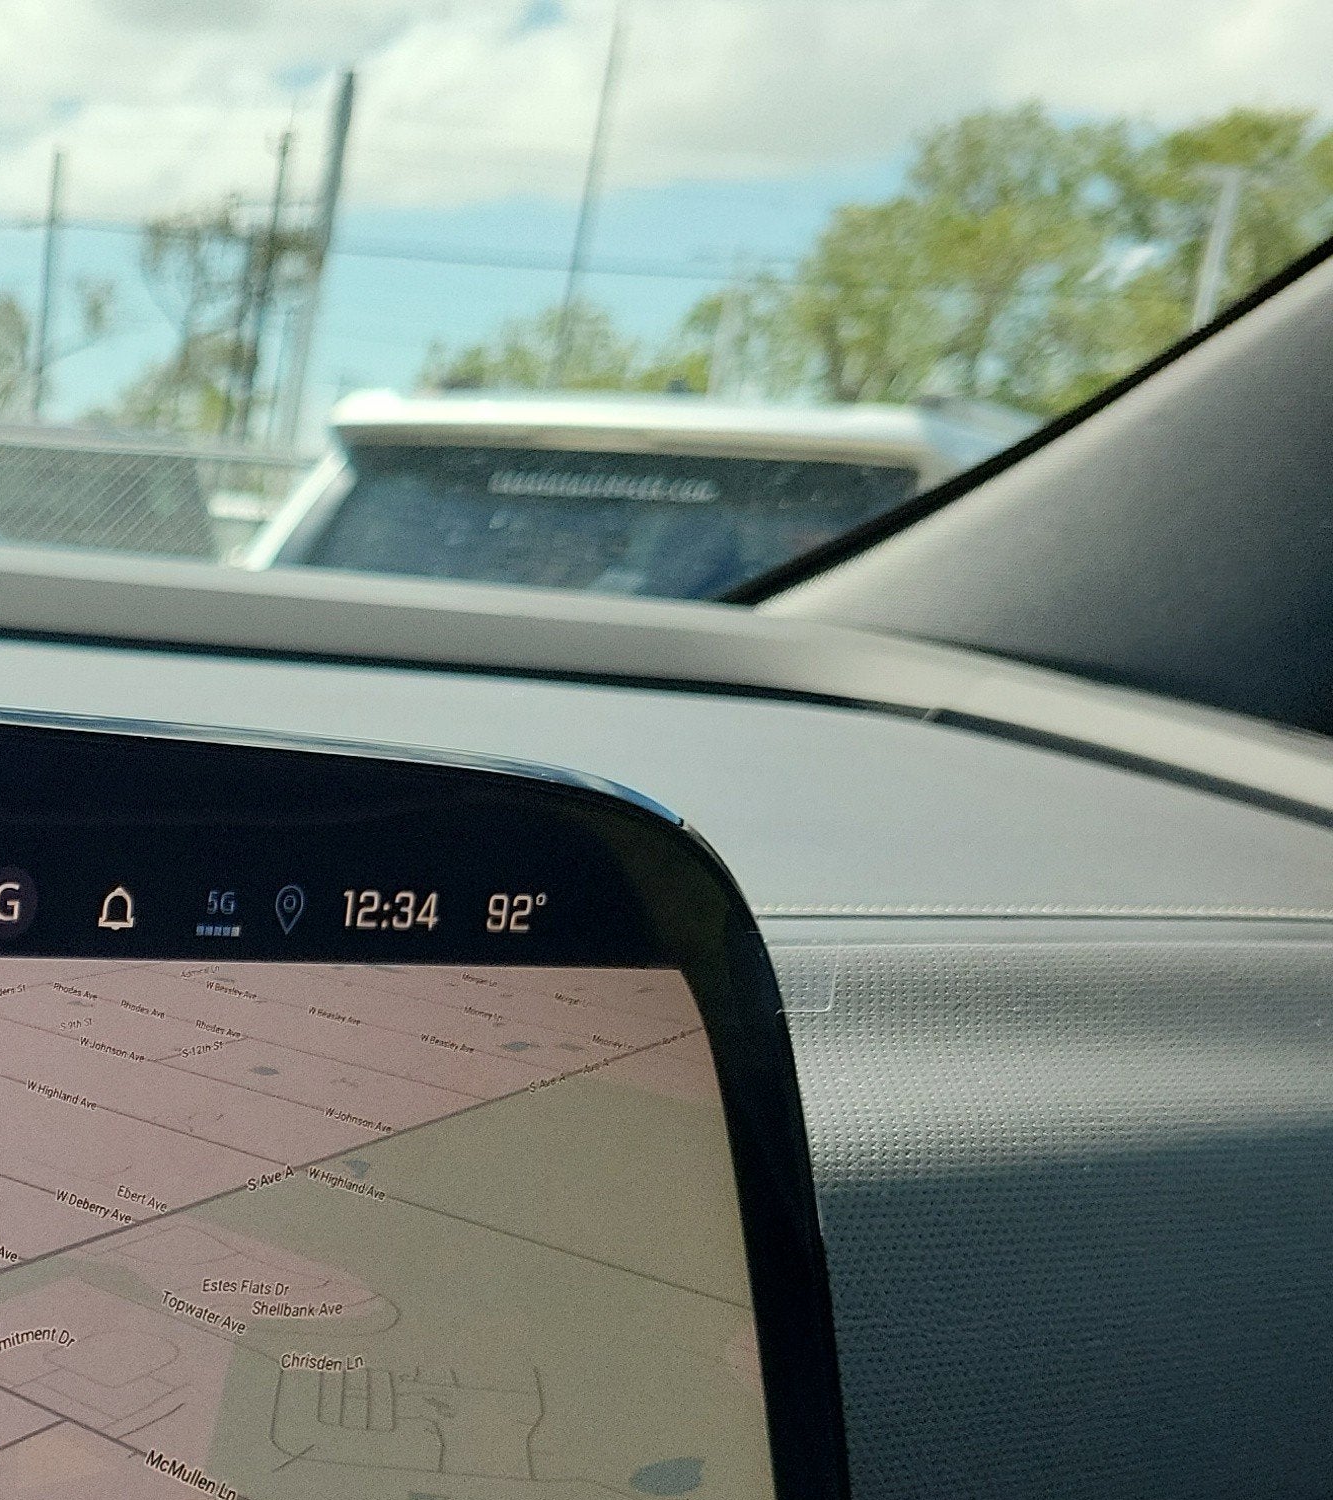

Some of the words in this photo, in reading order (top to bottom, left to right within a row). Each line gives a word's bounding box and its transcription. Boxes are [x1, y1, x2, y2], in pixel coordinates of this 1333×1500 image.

[207, 891, 235, 915] 5G
[342, 890, 439, 931] 12:34
[486, 891, 546, 933] 92°
[325, 1107, 335, 1118] W
[375, 1122, 392, 1132] Ave
[247, 1177, 257, 1191] S
[260, 1170, 282, 1187] Ave
[283, 1165, 294, 1179] A
[308, 1166, 320, 1179] W
[321, 1170, 365, 1196] Highland
[365, 1184, 385, 1200] Ave
[117, 1185, 145, 1208] Ebert
[146, 1195, 167, 1212] Ave
[202, 1279, 237, 1292] Estes
[239, 1280, 271, 1295] Flats
[274, 1282, 289, 1296] Dr
[161, 1290, 220, 1324] Topwater
[221, 1316, 245, 1334] Ave
[252, 1301, 315, 1317] Shellbank
[317, 1302, 343, 1316] Ave
[59, 1329, 75, 1347] Dr
[281, 1355, 342, 1371] Chrisden
[346, 1355, 363, 1370] Ln
[146, 1451, 217, 1495] McMullen
